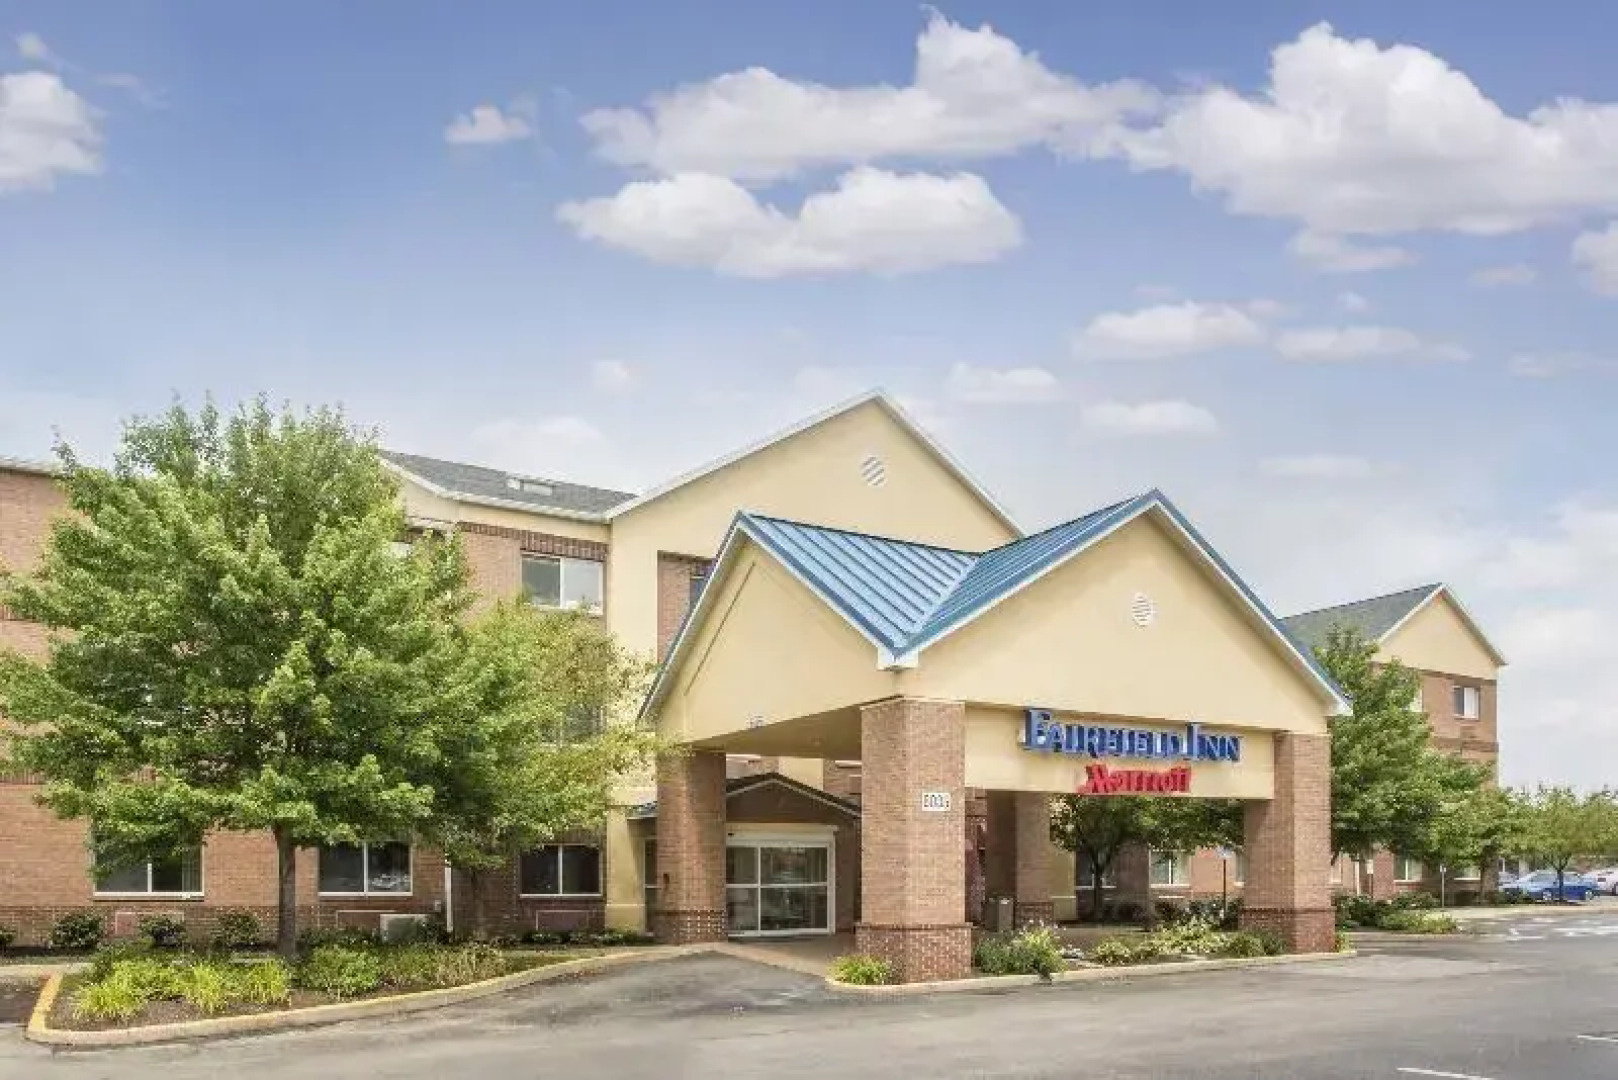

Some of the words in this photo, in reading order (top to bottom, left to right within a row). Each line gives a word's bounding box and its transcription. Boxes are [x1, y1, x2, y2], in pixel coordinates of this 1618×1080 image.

[1020, 708, 1185, 759] FAIRFIELD
[1184, 721, 1240, 762] INN
[1078, 764, 1192, 794] Marriott
